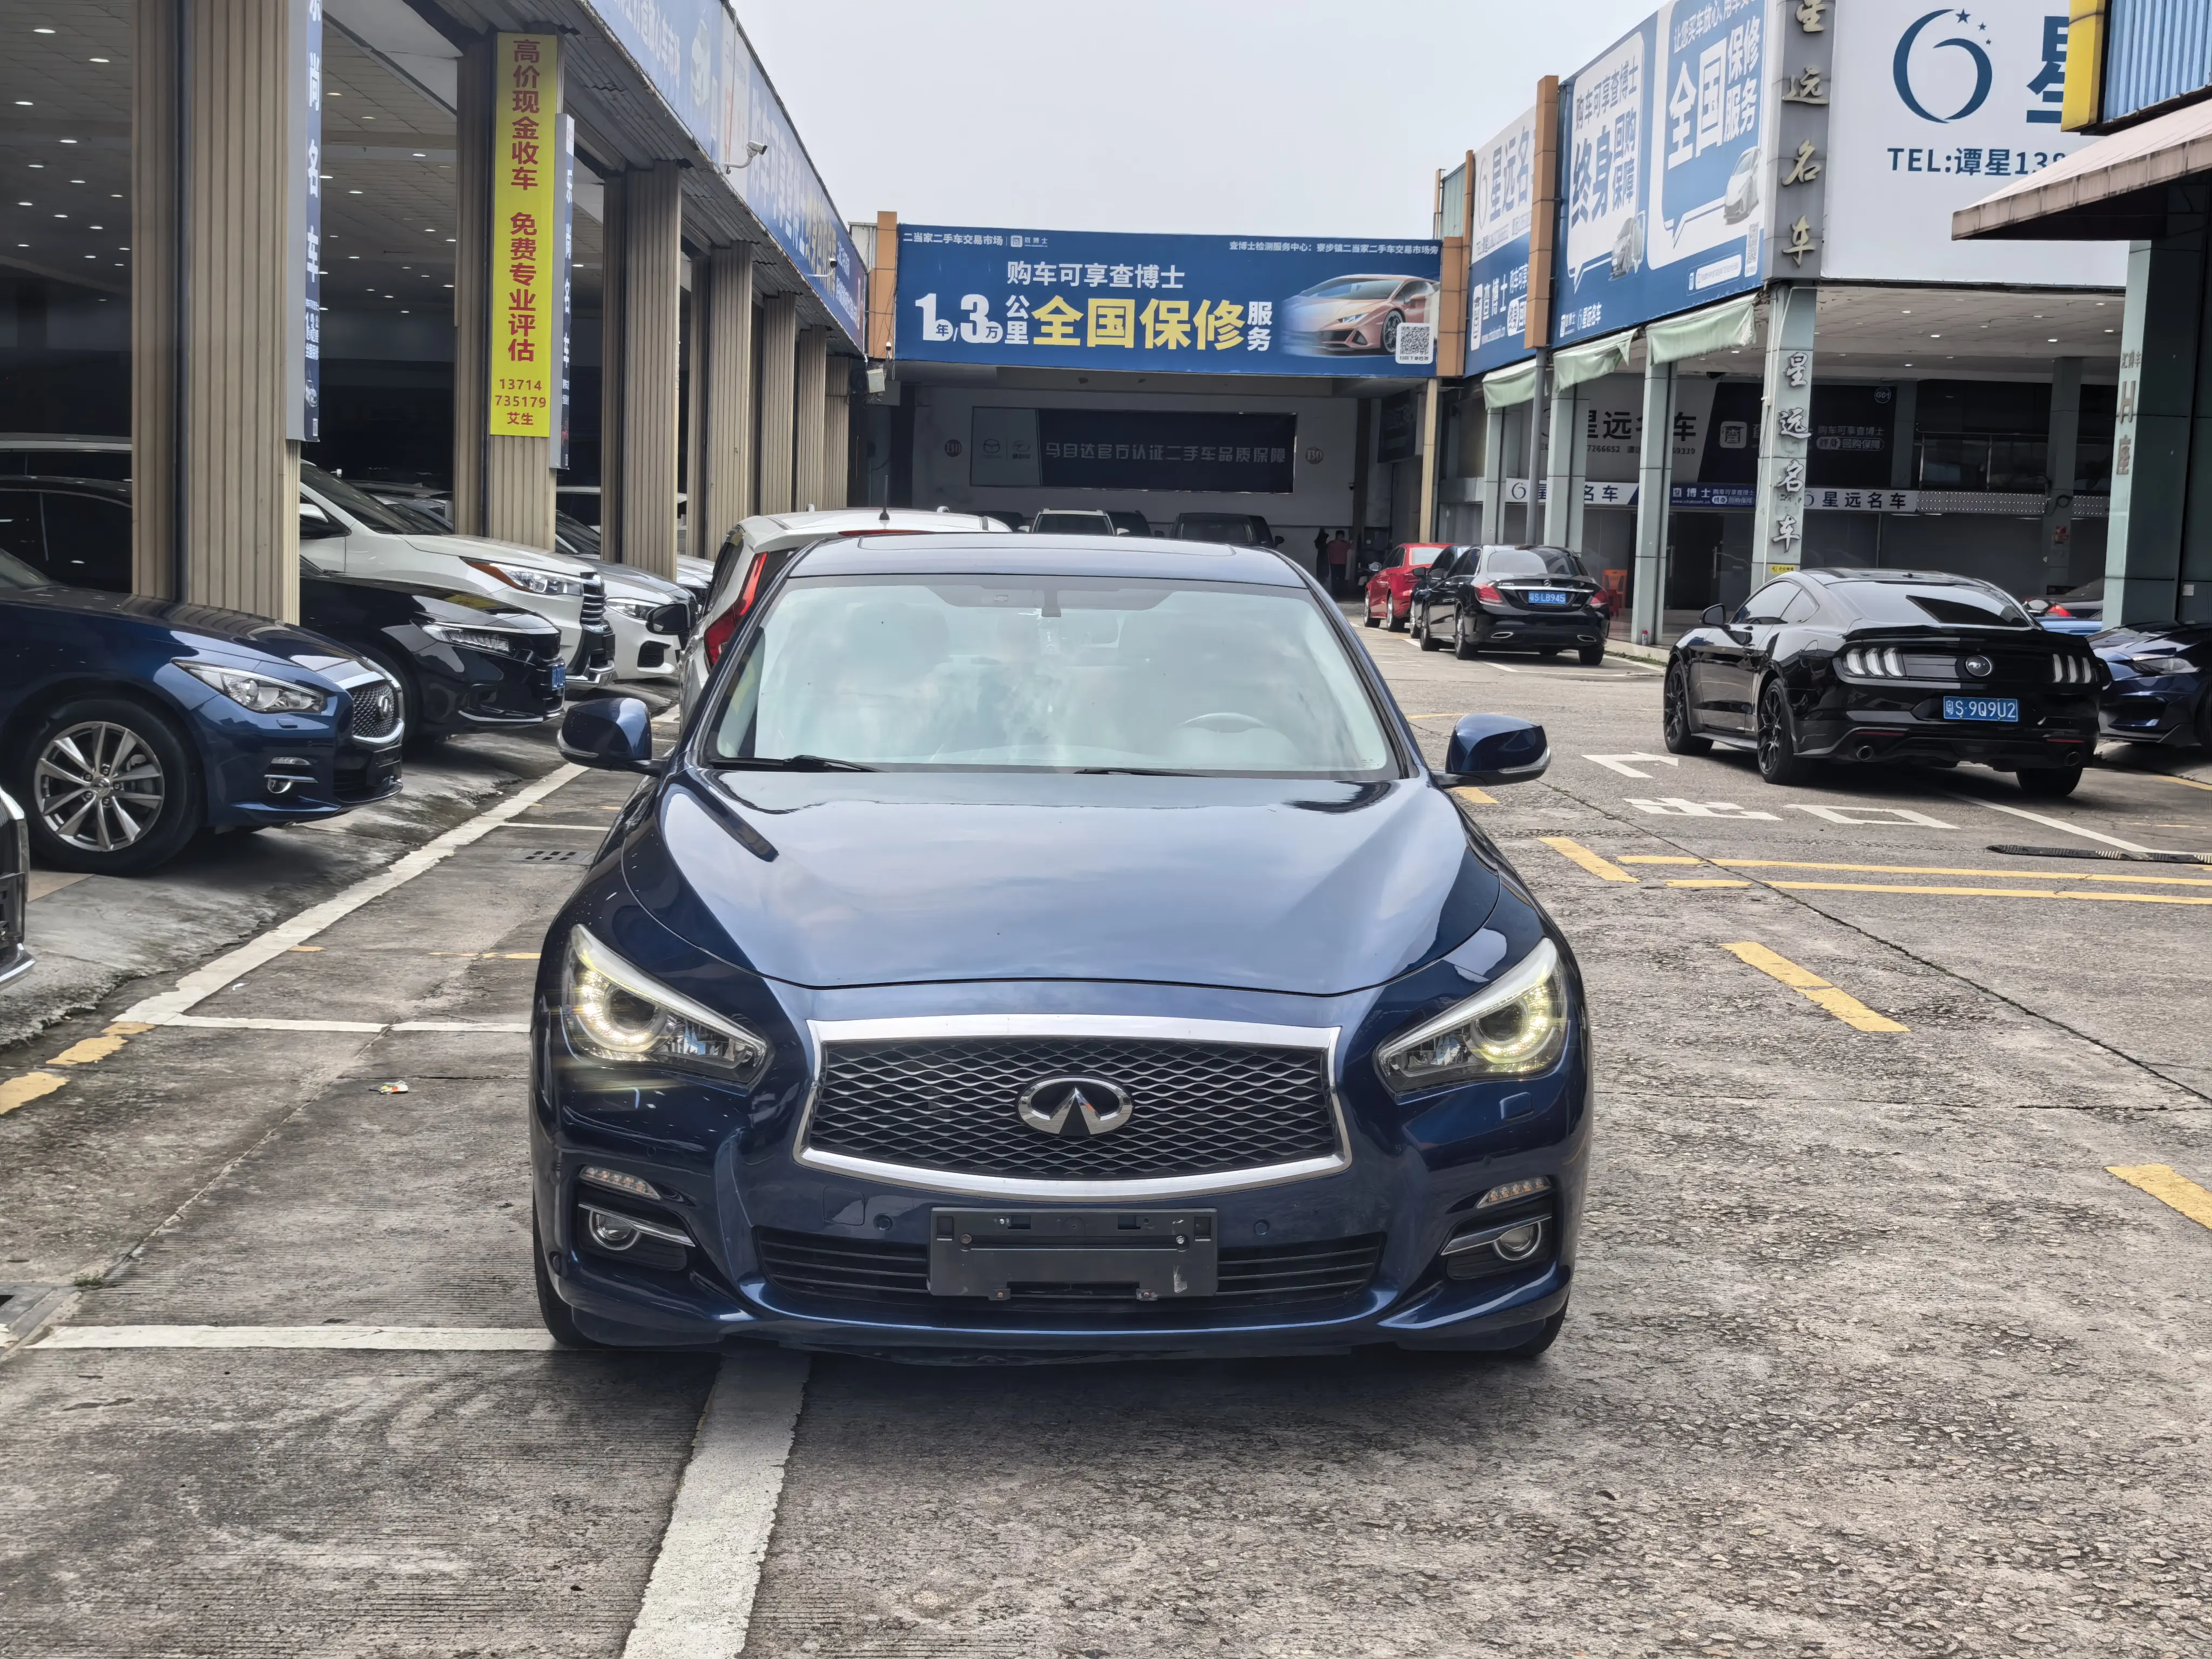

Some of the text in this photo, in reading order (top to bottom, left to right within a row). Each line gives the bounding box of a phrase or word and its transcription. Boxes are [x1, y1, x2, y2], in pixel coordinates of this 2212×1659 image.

[1728, 16, 1761, 84] 保修
[1575, 54, 1638, 132] 购车可享查博士
[1668, 37, 1728, 170] 全国
[1723, 77, 1758, 142] 服务
[508, 39, 541, 362] 高价现金收车 免费专业评估
[1489, 125, 1536, 223] 星远名
[1572, 125, 1613, 229] 终身
[903, 232, 1003, 246] 二当家二手车交易市场
[1007, 261, 1185, 289] 购车可享查博士
[1031, 295, 1245, 351] 全国保修
[1247, 301, 1273, 352] 服务
[494, 395, 547, 408] 735179
[499, 378, 542, 392] 13714
[506, 412, 534, 426] 艾生
[1046, 442, 1286, 463] 马自达官方认证二手车品质保障
[1772, 352, 1812, 554] 星远名车
[1822, 491, 1906, 509] 星远名车
